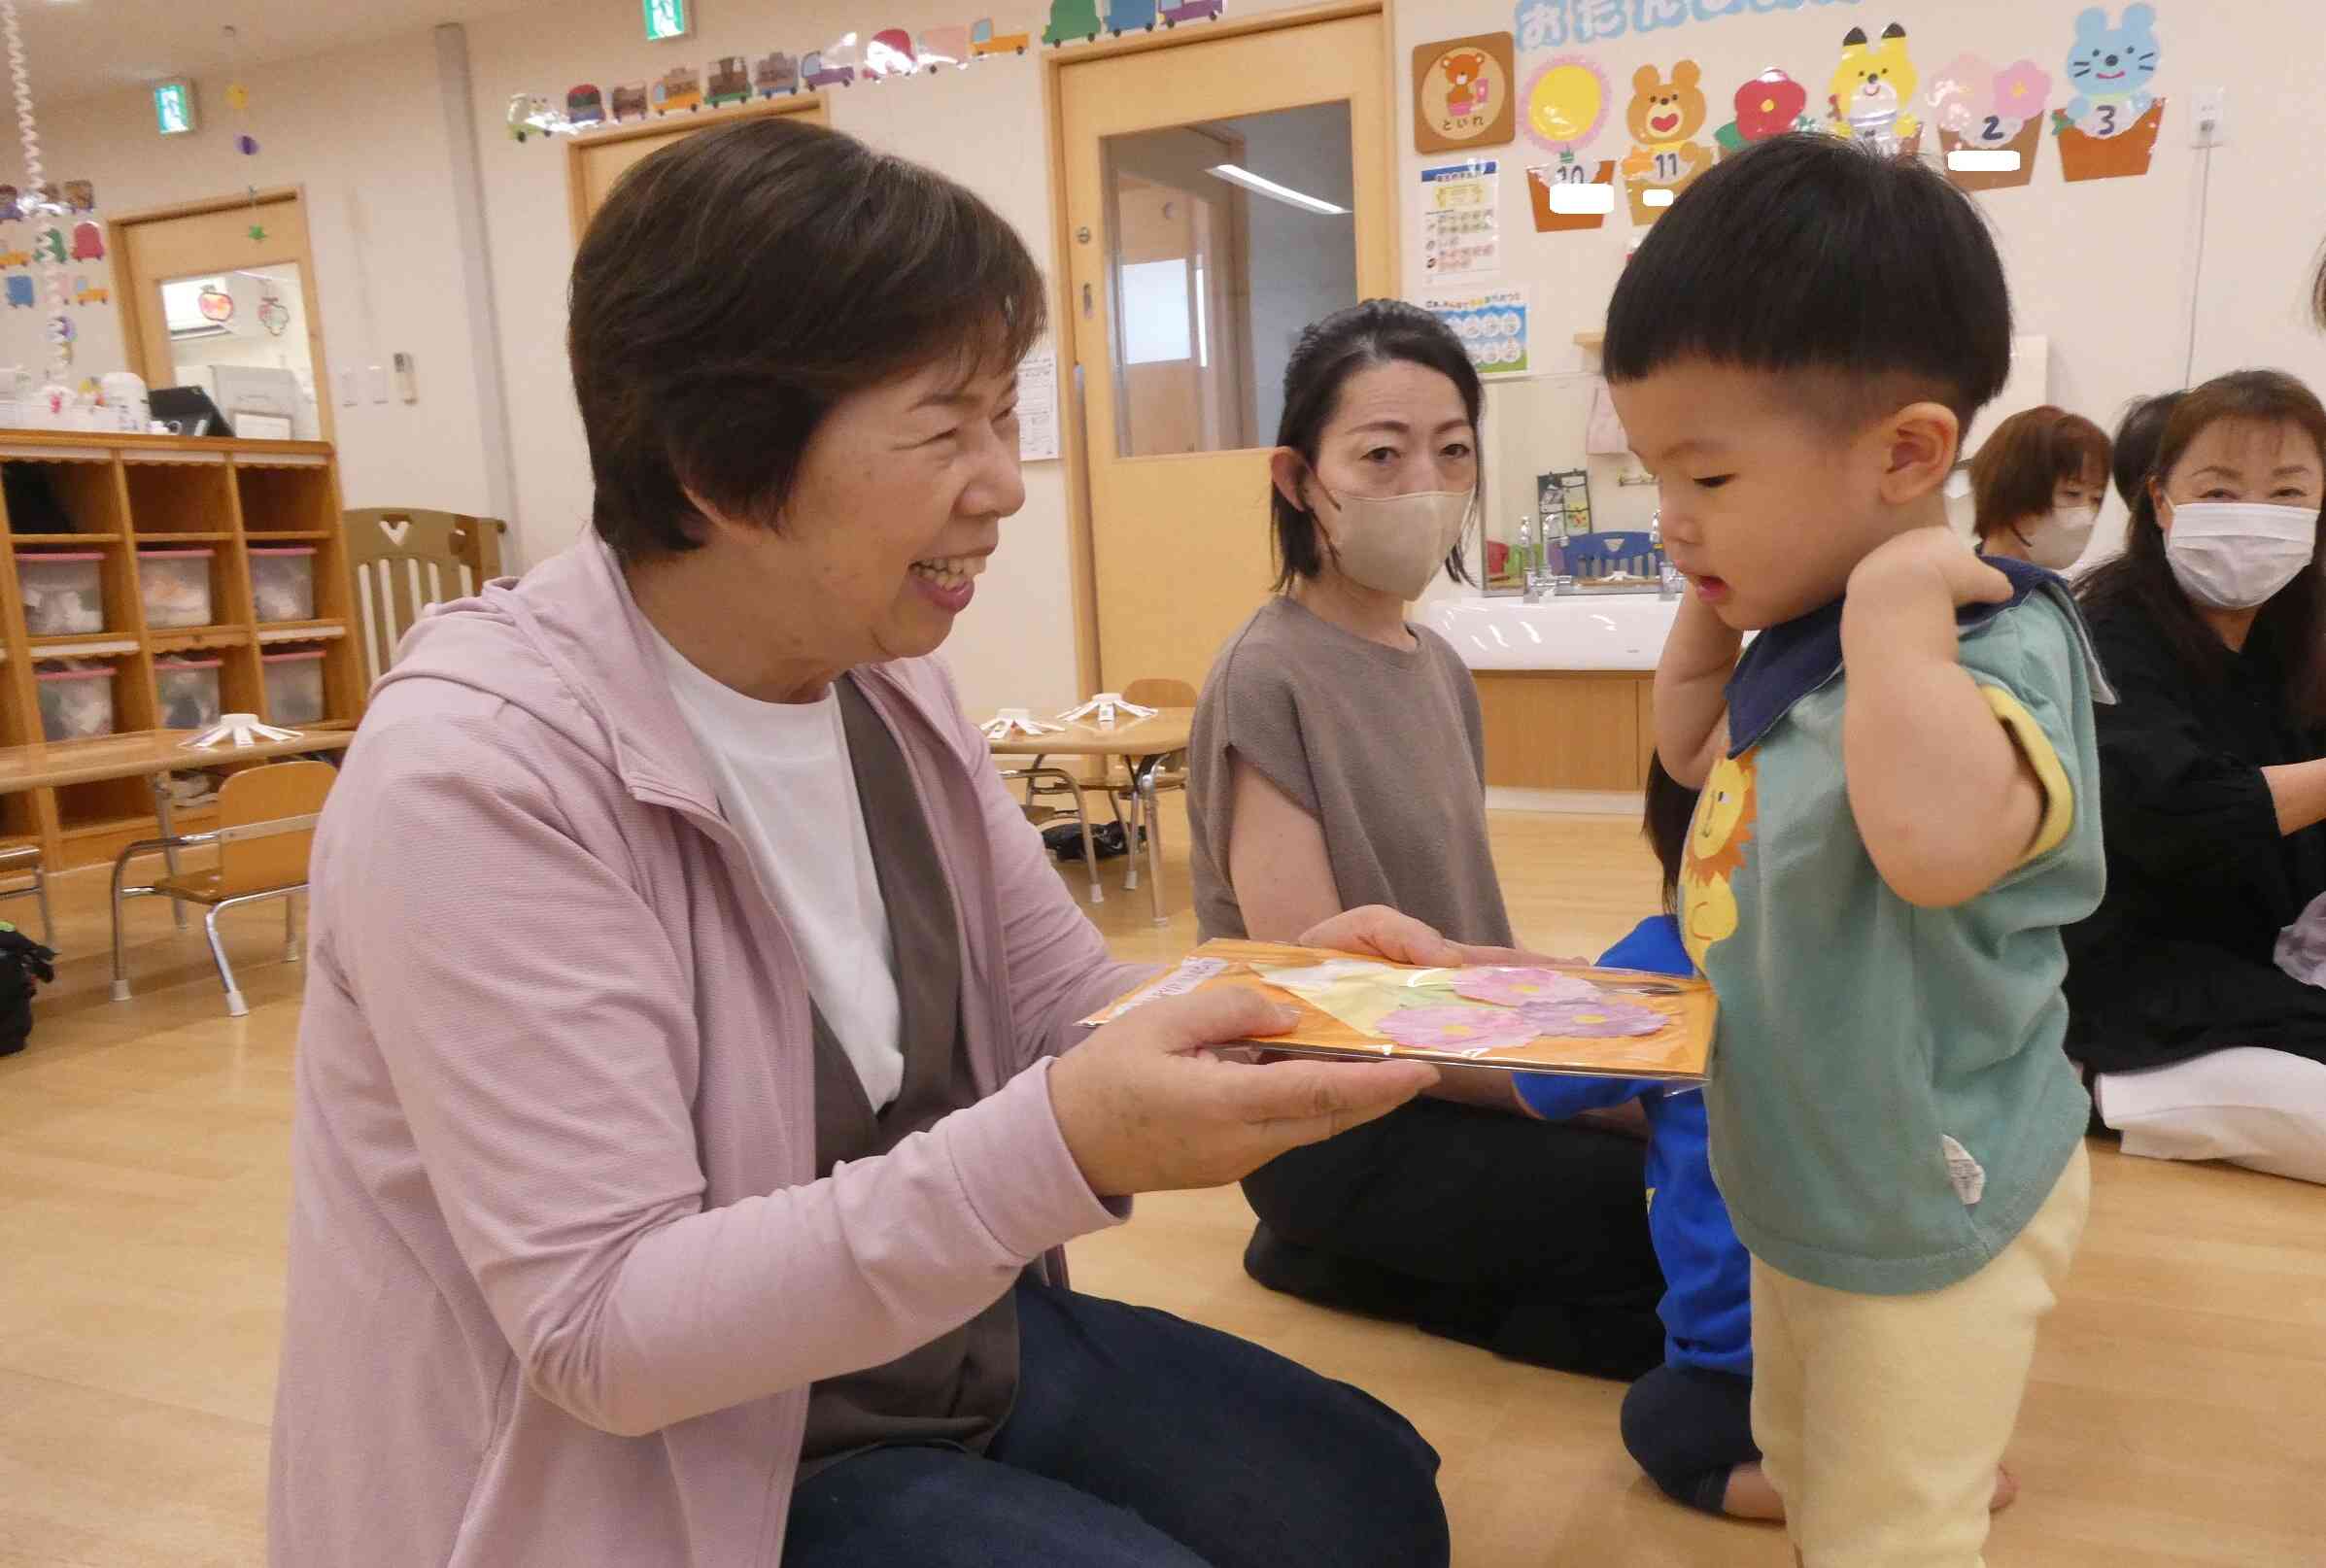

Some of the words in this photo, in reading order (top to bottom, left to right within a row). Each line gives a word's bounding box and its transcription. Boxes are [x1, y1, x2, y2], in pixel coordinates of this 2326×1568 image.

[1443, 116, 1485, 131] といれ
[1981, 115, 2003, 140] 2
[2096, 104, 2116, 135] 3
[1655, 153, 1678, 179] 11
